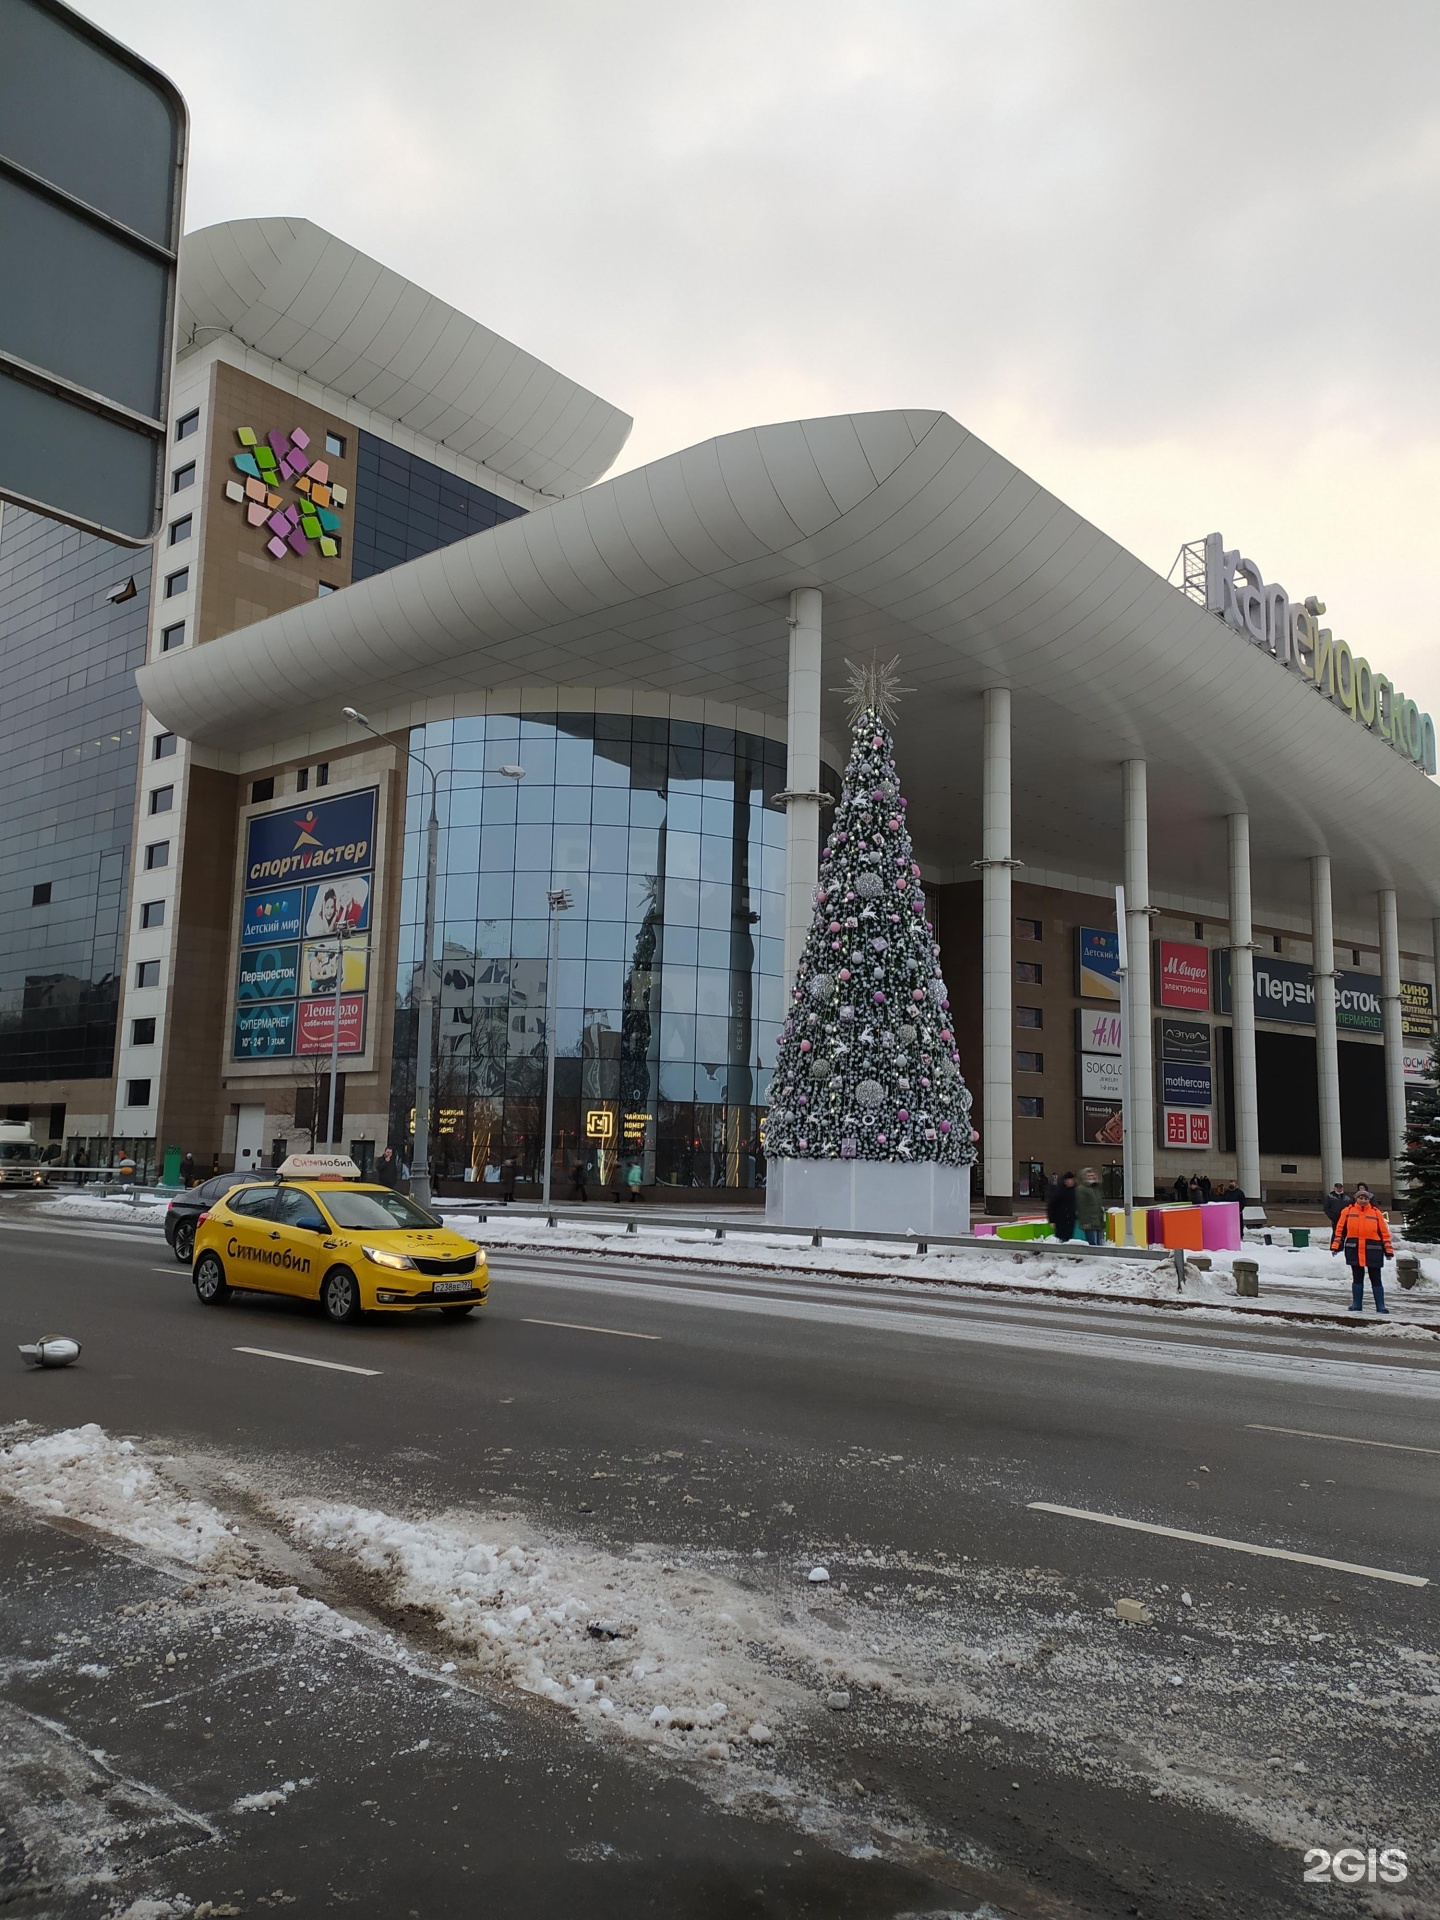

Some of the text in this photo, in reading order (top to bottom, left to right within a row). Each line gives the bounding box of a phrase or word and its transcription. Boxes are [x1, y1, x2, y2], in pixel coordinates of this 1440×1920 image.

[244, 918, 300, 936] Детский мир
[1083, 947, 1114, 960] Детский
[241, 967, 295, 984] Перекресток
[1163, 983, 1208, 995] электроника
[1256, 971, 1382, 1014] Перекесток
[1400, 983, 1429, 997] КИНО
[240, 1016, 290, 1031] СУПЕРМАРКЕТ
[736, 990, 744, 1051] RESERVED
[1092, 1016, 1121, 1049] H&M
[1402, 1021, 1431, 1034] 8 ЗАЛОВ
[1165, 1076, 1210, 1089] mothercare
[624, 1112, 653, 1121] ЧАЙХОНА
[1192, 1117, 1206, 1129] UNI
[1192, 1130, 1208, 1142] QLO
[292, 1157, 353, 1168] Ситимобил
[227, 1236, 311, 1274] Ситимобил
